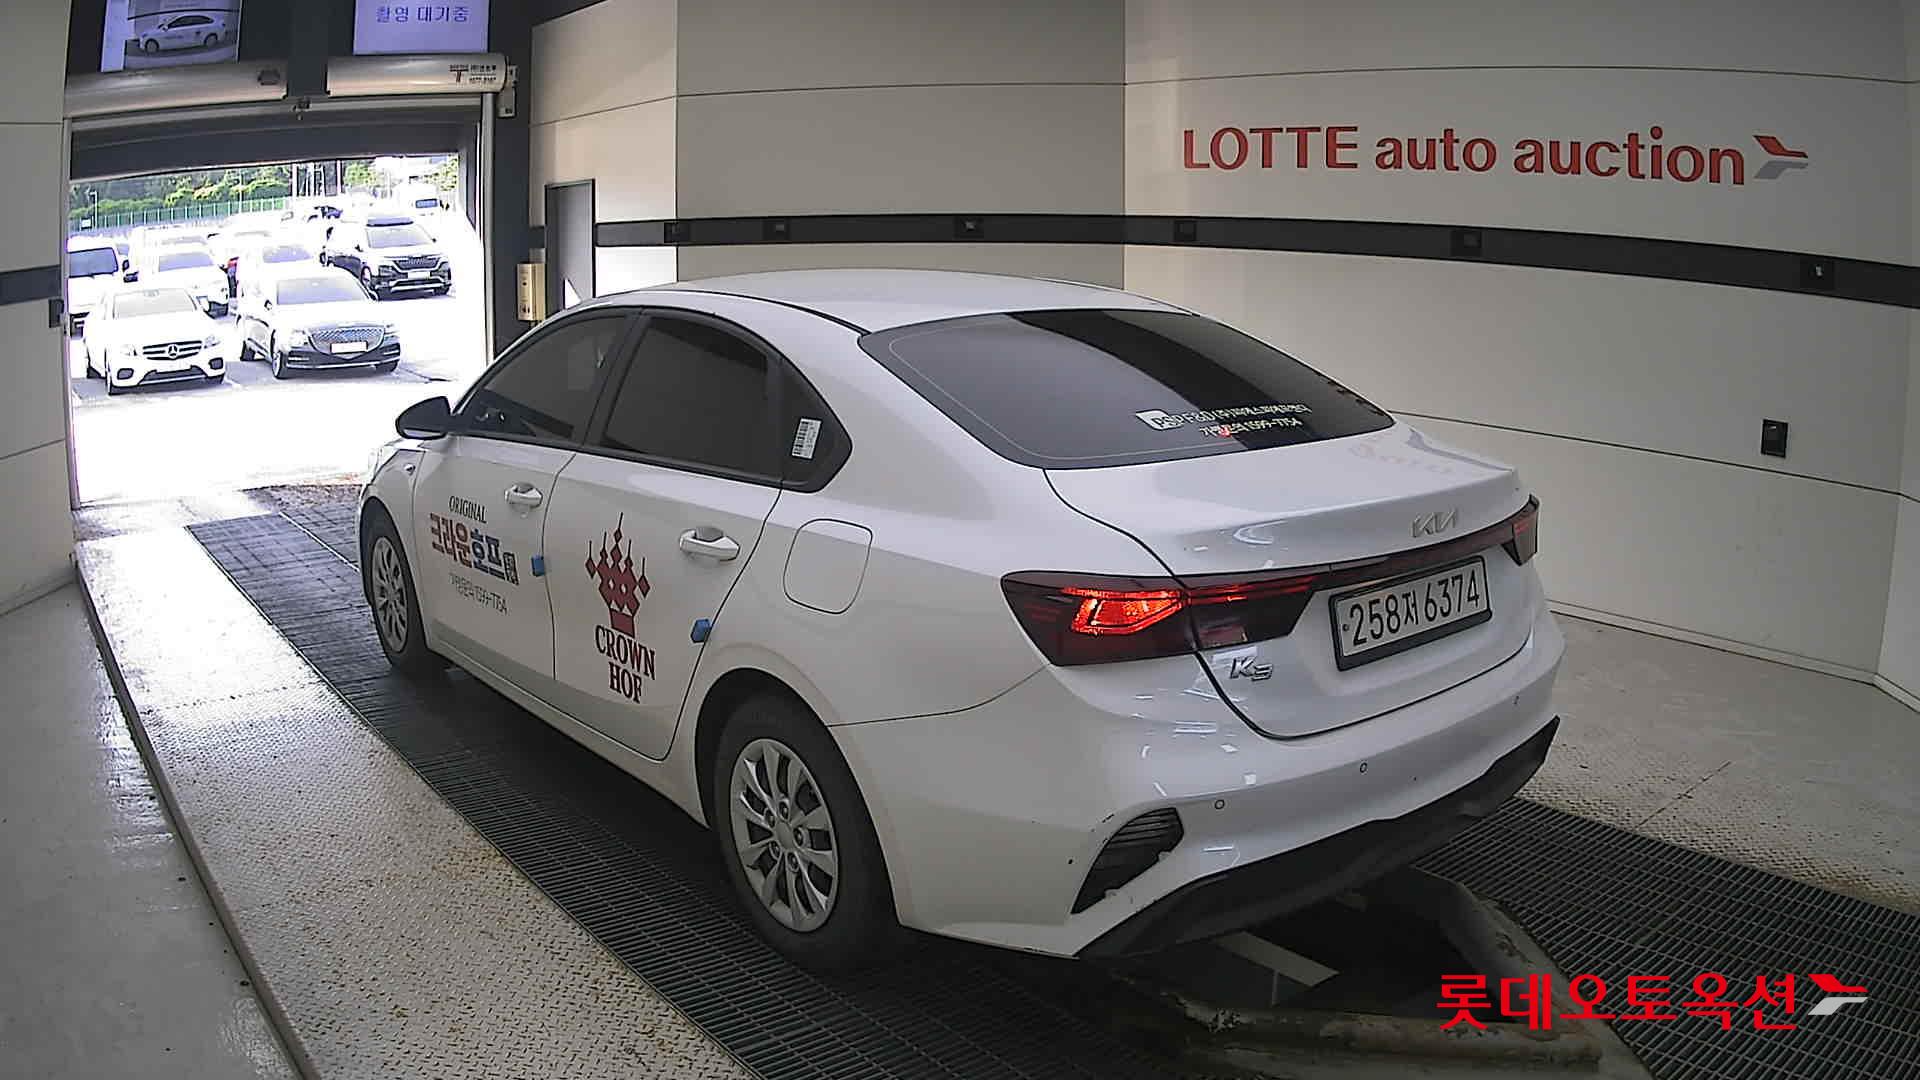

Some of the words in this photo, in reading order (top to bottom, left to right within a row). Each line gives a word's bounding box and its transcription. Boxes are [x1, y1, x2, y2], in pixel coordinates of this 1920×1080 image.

[417, 4, 469, 23] 대기중
[1183, 125, 1358, 170] LOTTE
[1375, 128, 1497, 173] auto
[1513, 125, 1746, 186] auction
[448, 495, 488, 524] ORIGINAL
[429, 512, 506, 581] 크라운호프
[1349, 590, 1419, 646] 258저
[1425, 569, 1480, 622] 6374
[595, 624, 656, 681] CROWN
[1230, 656, 1273, 681] K3
[608, 661, 642, 704] HOF
